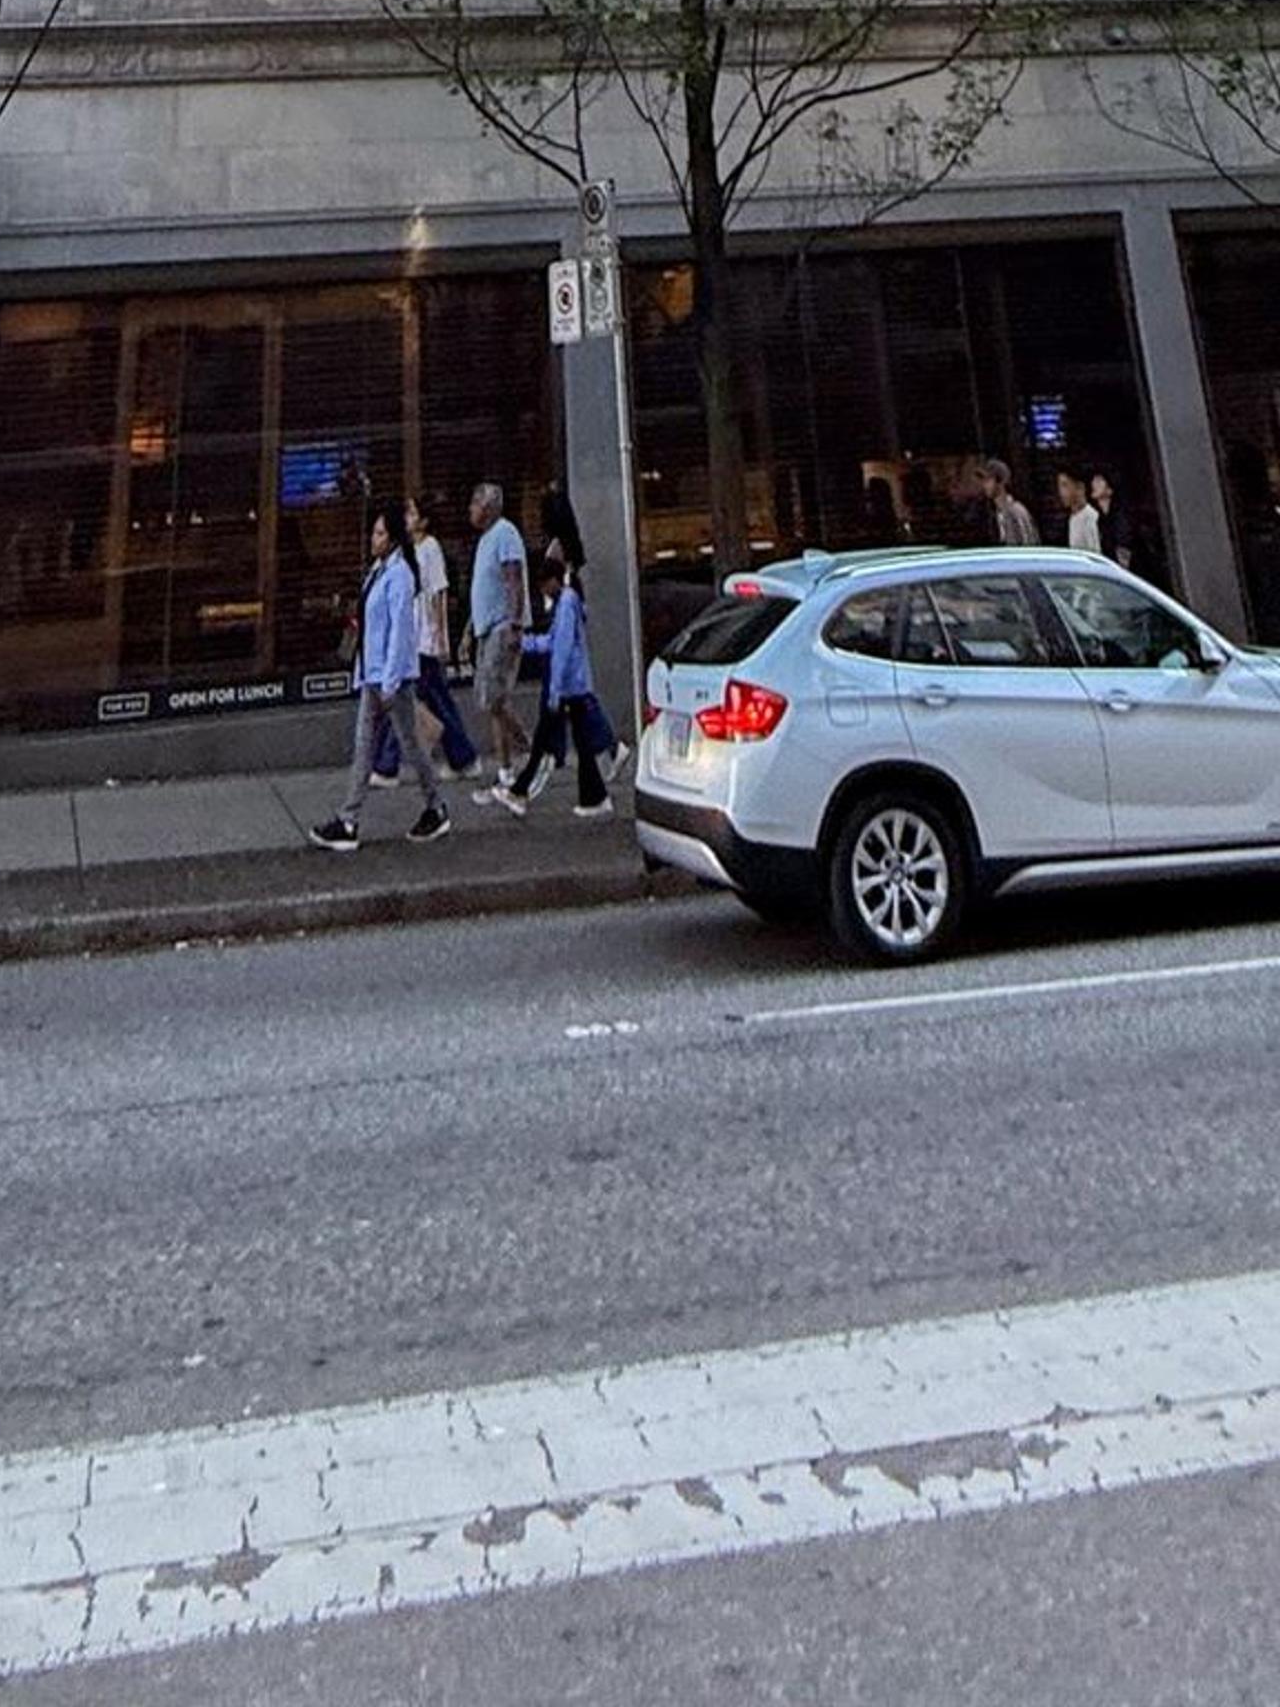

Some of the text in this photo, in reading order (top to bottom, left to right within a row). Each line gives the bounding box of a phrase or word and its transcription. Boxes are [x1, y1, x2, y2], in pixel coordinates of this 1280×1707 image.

[169, 682, 285, 710] OPEN FOR LUNCH
